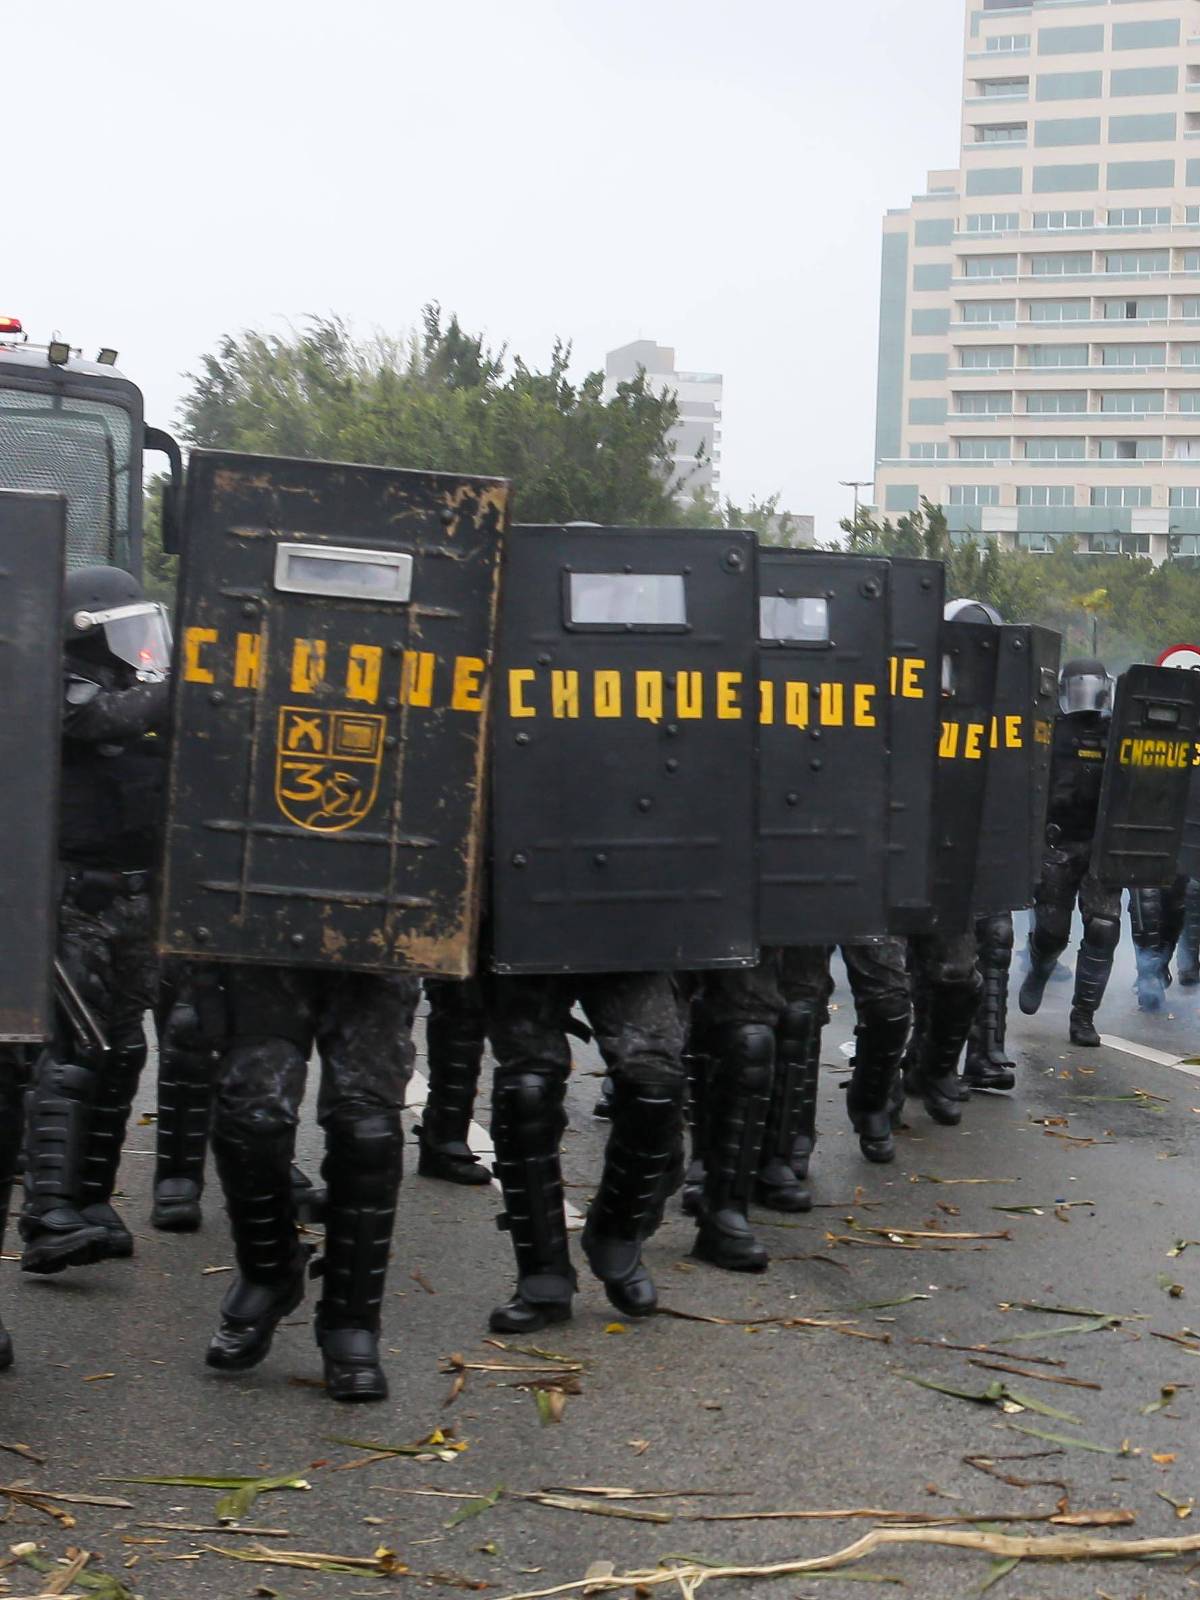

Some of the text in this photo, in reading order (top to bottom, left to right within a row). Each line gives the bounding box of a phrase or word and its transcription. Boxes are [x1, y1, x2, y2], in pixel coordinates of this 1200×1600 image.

[184, 626, 486, 712] CHOQUE
[508, 669, 742, 724] CHOQUE
[938, 721, 984, 759] UE
[1120, 738, 1190, 768] CHOQUE
[280, 761, 327, 801] 3
